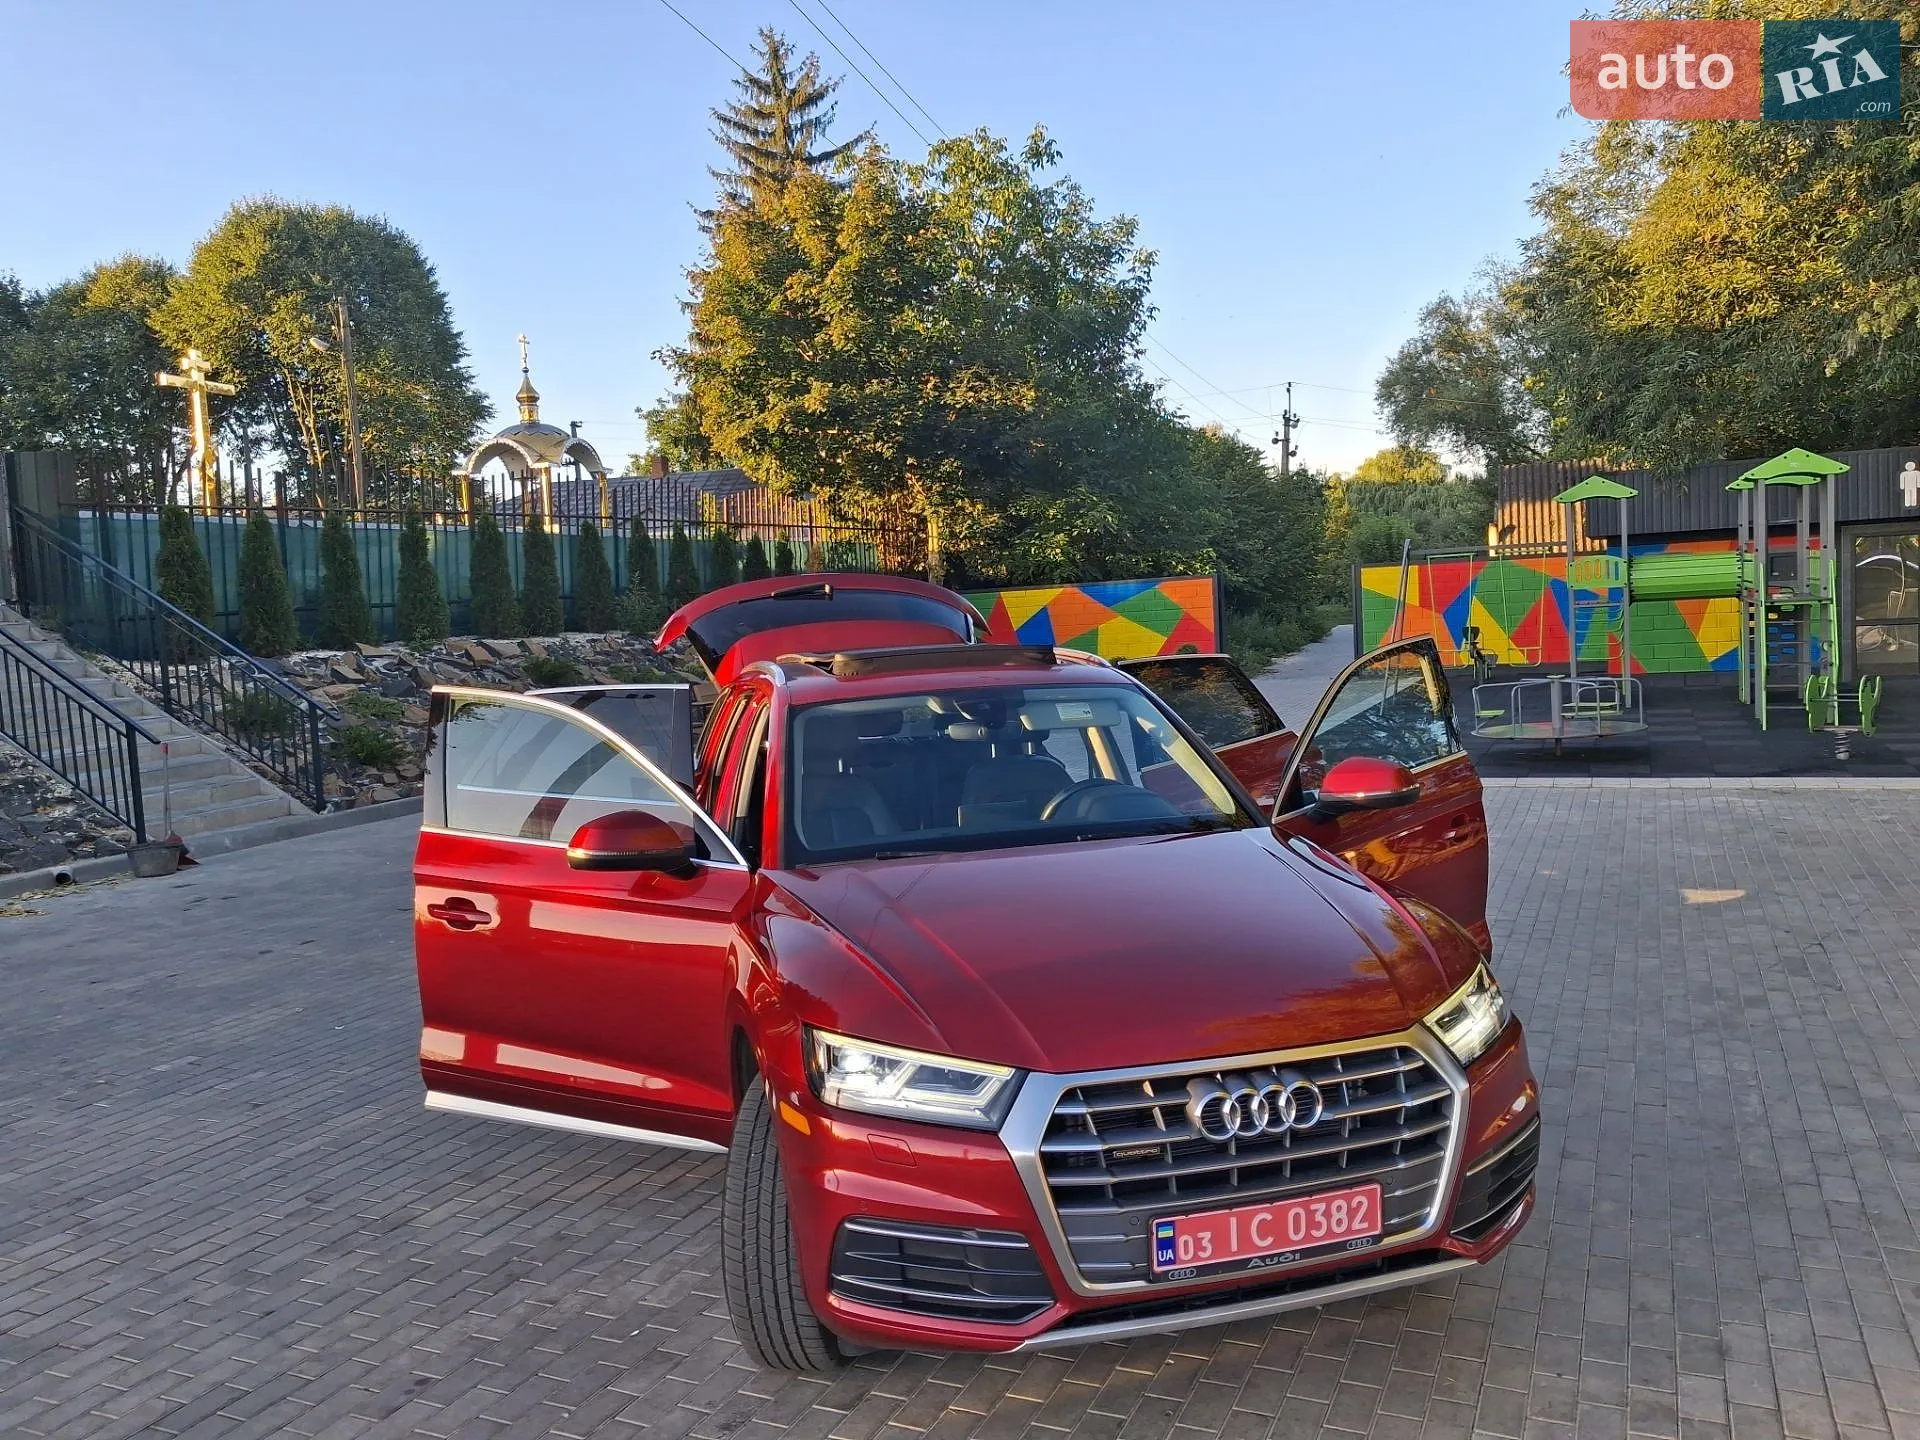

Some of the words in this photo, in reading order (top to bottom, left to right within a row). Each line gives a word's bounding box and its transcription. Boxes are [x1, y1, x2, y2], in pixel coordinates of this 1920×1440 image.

[1178, 1231, 1213, 1261] 03
[1287, 1195, 1369, 1242] 0382
[1158, 1249, 1174, 1262] UA
[1247, 1252, 1300, 1269] Audi
